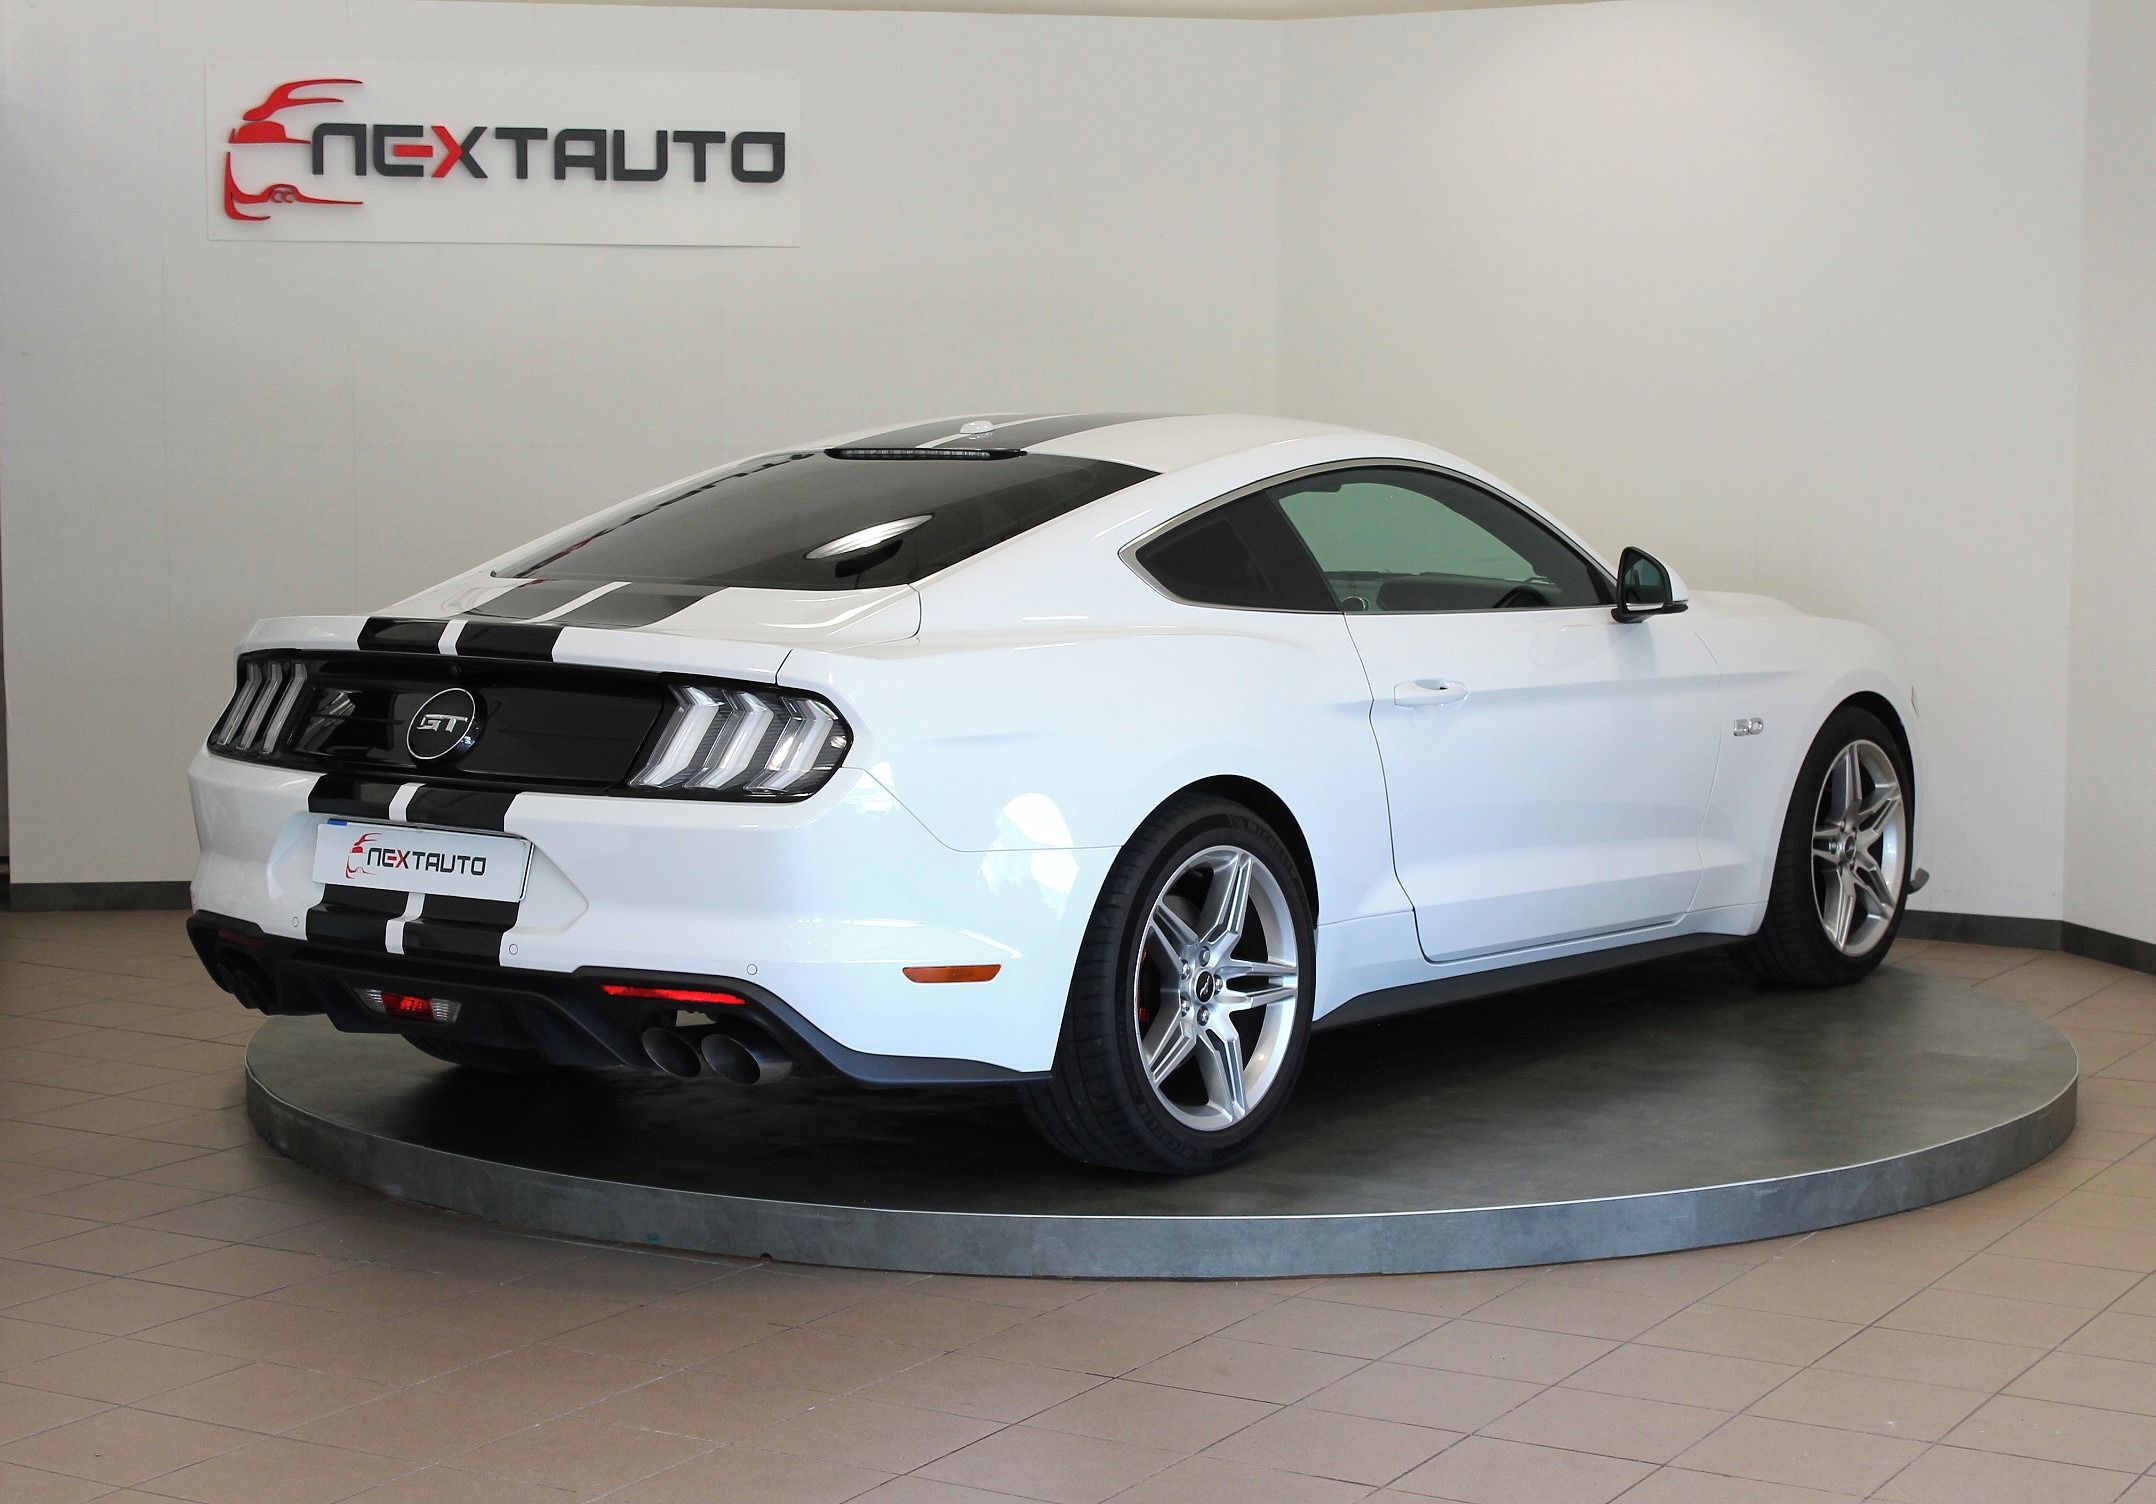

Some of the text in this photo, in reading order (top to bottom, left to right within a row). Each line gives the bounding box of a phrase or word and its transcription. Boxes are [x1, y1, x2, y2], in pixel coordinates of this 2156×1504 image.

[312, 122, 786, 183] NEXTAUTO
[416, 713, 468, 733] GT
[366, 847, 487, 877] NEXTAUTO
